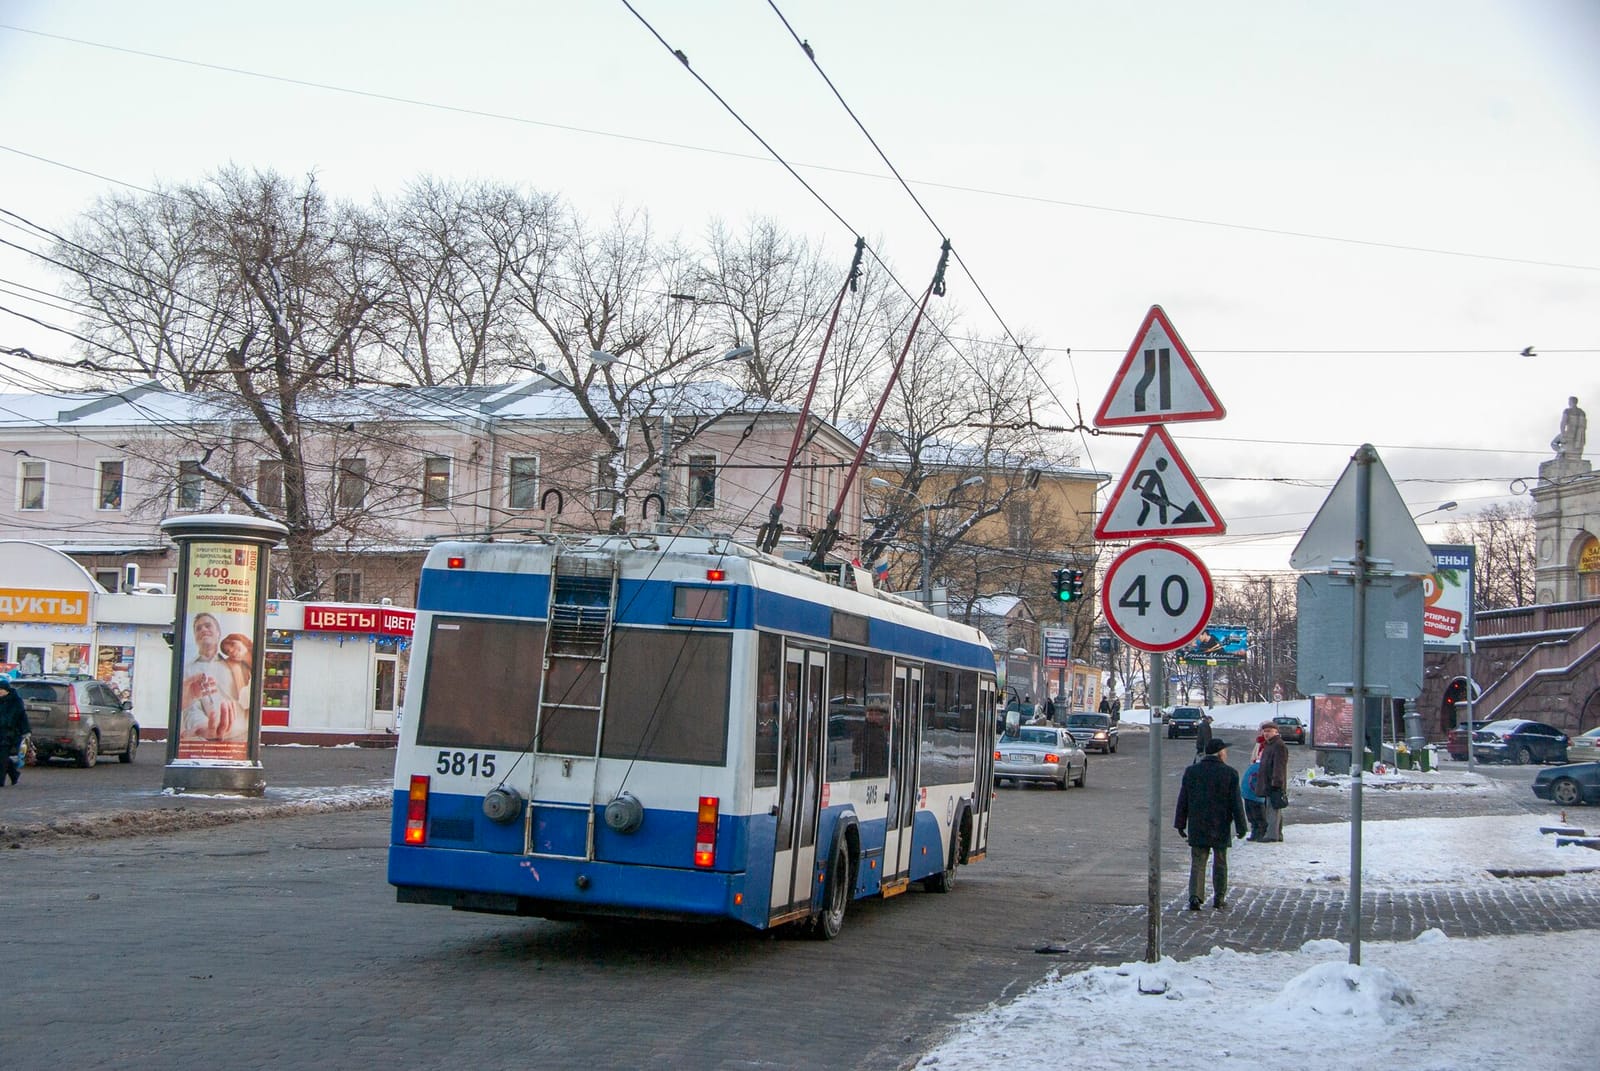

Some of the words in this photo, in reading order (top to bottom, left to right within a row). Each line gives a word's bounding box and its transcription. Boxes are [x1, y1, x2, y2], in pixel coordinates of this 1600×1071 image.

[1435, 555, 1469, 566] ЕНЫ!
[203, 567, 229, 578] 400
[218, 578, 250, 586] семей
[1118, 574, 1189, 617] 40
[310, 611, 376, 628] ЦВЕТЫ
[436, 750, 496, 778] 5815
